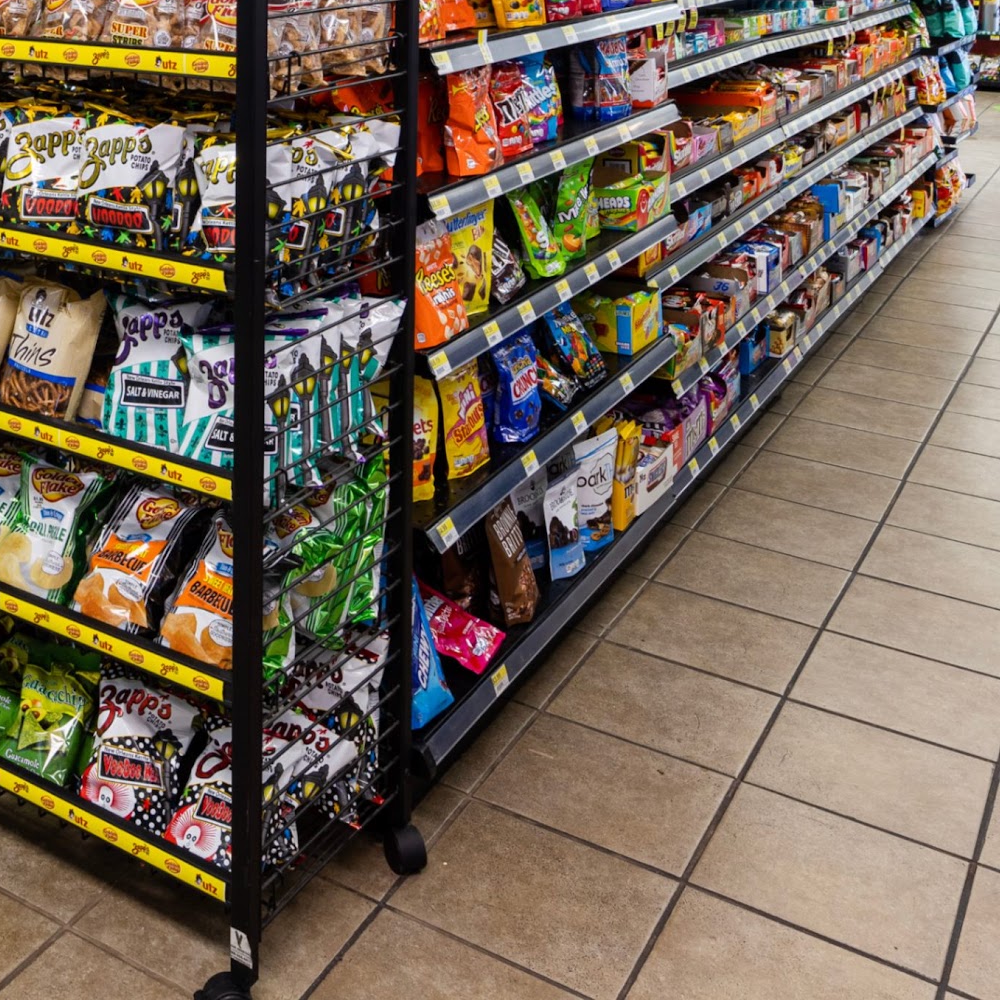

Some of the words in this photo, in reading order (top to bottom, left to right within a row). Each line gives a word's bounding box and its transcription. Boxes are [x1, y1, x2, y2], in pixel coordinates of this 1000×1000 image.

[111, 22, 148, 39] SUPER
[34, 49, 49, 60] utz
[162, 58, 178, 71] utz
[131, 155, 151, 164] POTATO
[131, 162, 149, 171] CHIPS
[447, 210, 487, 232] utterfinger
[7, 236, 20, 247] utz
[129, 261, 143, 272] utz
[12, 333, 57, 368] Thins
[126, 385, 143, 398] SALT
[148, 387, 180, 401] VINEGAR
[34, 468, 81, 485] Golden
[39, 479, 77, 497] Flake
[99, 641, 113, 652] utz
[97, 685, 173, 737] Zapp's
[5, 748, 40, 770] Guacamole
[75, 816, 89, 829] utz
[203, 880, 218, 896] utz
